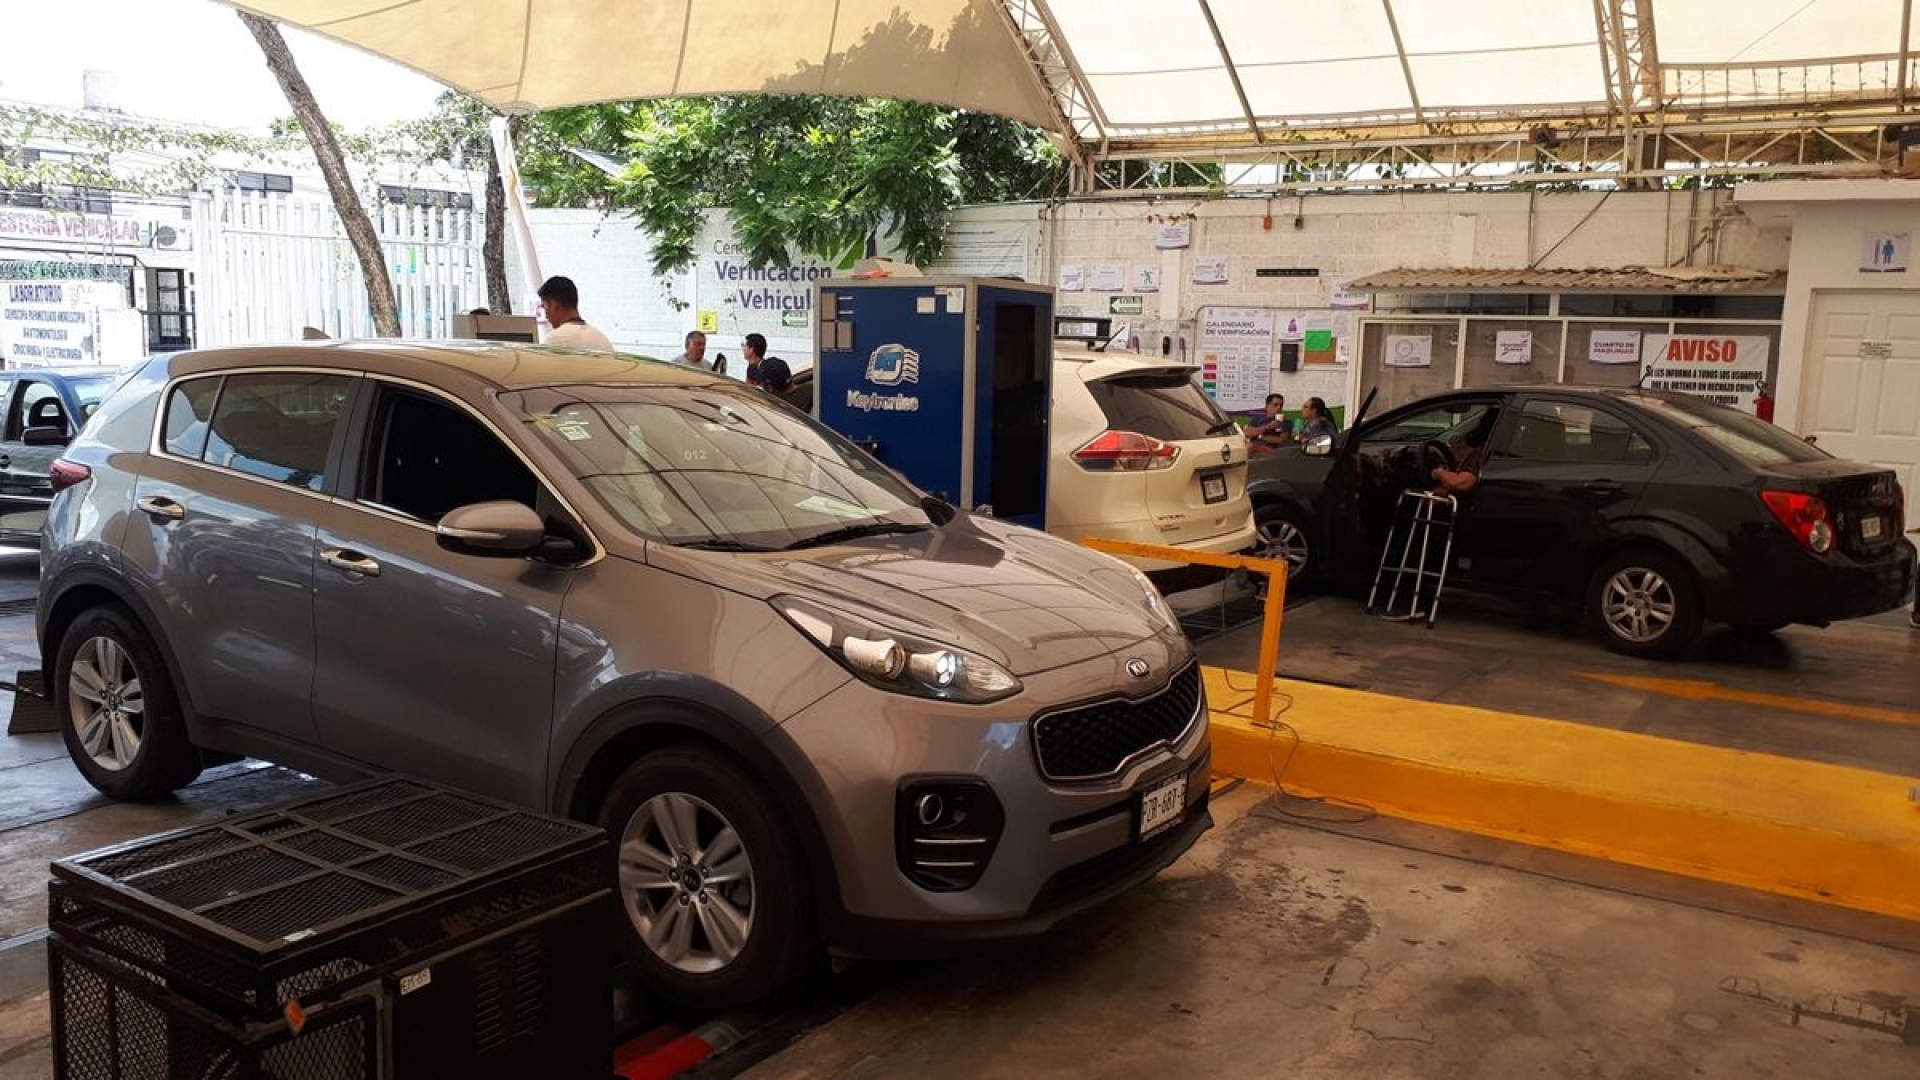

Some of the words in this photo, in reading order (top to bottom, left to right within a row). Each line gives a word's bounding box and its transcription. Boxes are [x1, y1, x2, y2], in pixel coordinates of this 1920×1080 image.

[739, 288, 811, 310] Vehicul
[1667, 339, 1737, 362] AVISO
[1665, 368, 1691, 378] INFORMA
[1698, 369, 1718, 379] TODOS
[1719, 369, 1730, 379] LOS
